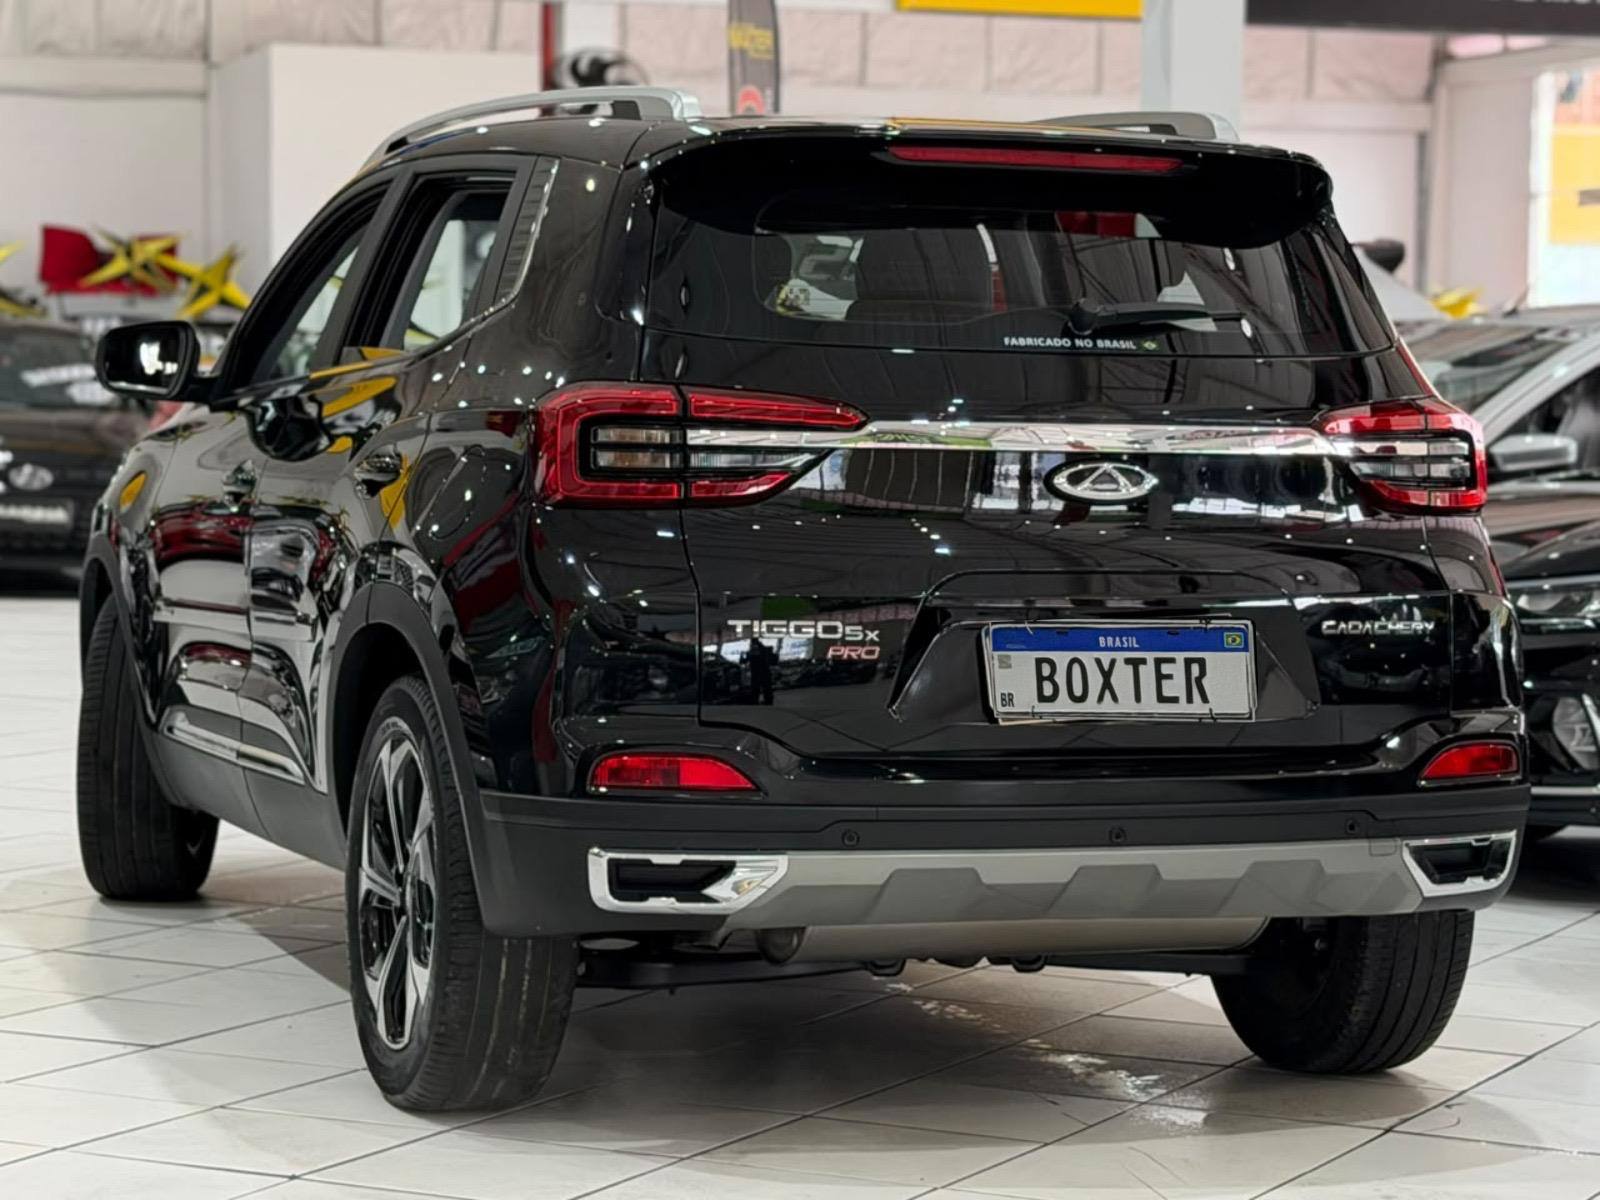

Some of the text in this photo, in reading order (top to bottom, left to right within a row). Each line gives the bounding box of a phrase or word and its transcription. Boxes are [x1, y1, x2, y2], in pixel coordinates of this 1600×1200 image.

[1003, 336, 1137, 350] FABRICADO NO BRASIL
[1098, 635, 1140, 648] BRASIL
[827, 645, 881, 661] PRO
[1034, 656, 1210, 705] BOXTER
[1000, 692, 1015, 708] BR
